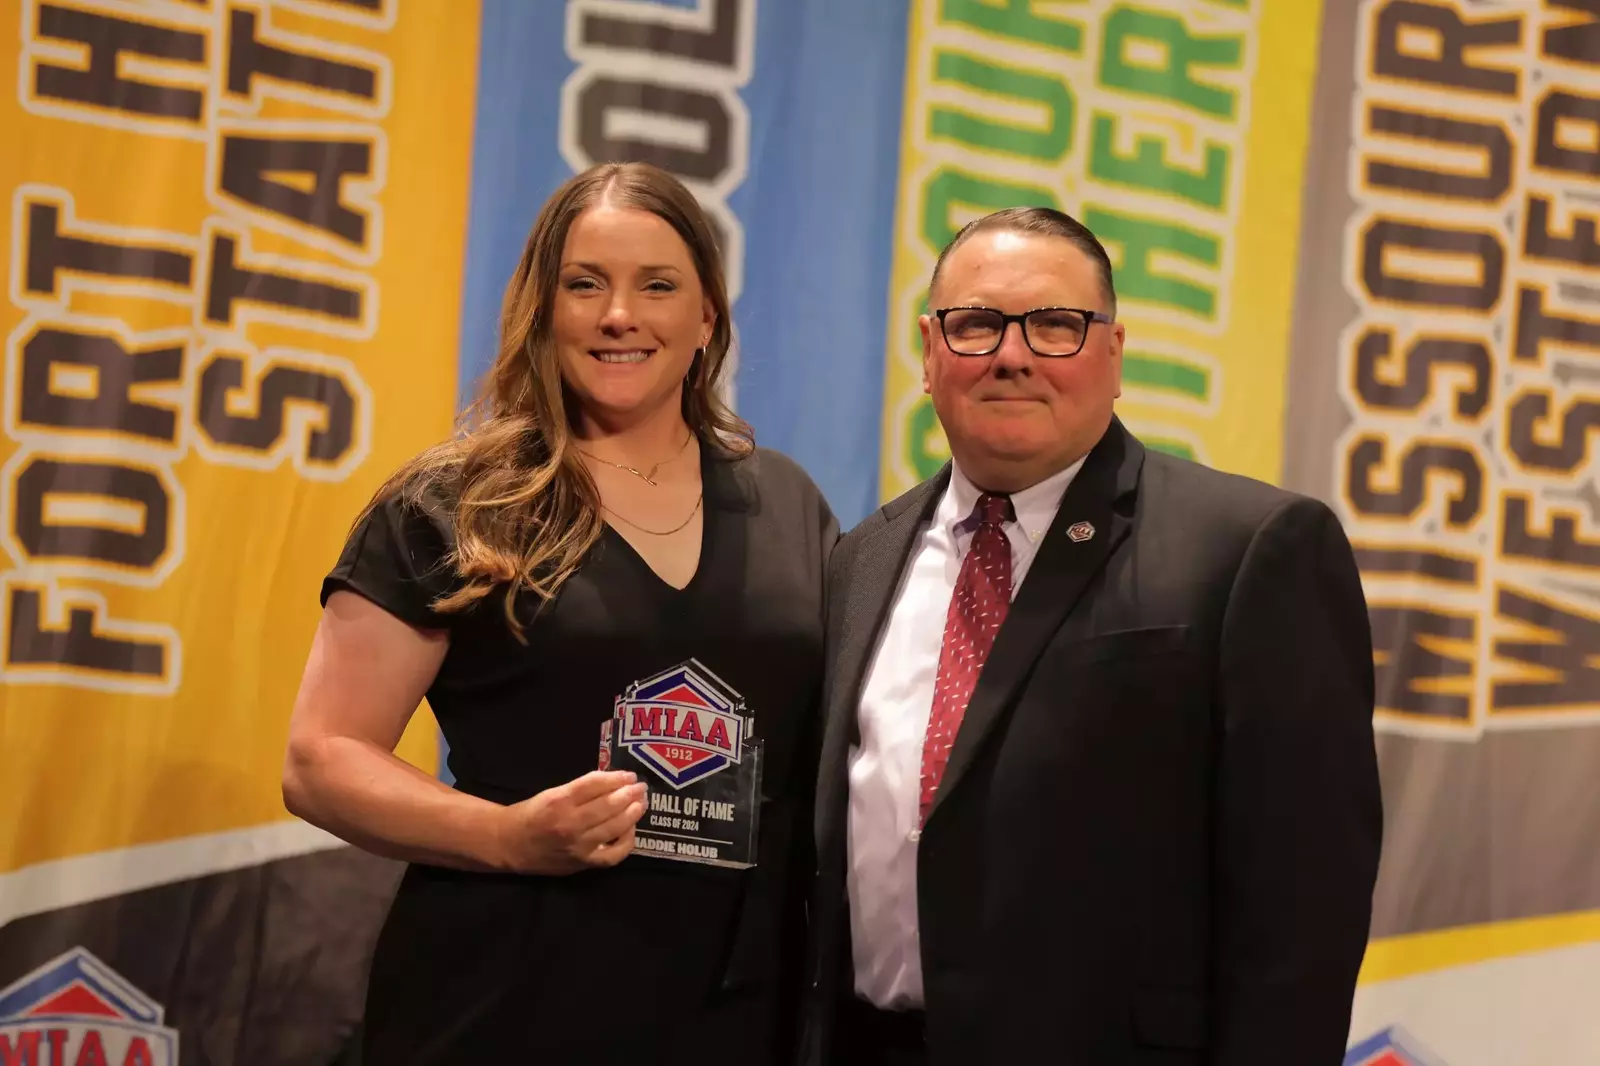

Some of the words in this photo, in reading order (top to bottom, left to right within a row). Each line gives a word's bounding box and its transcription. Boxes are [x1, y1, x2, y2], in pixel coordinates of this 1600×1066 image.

[195, 0, 392, 474] STAT
[3, 193, 203, 685] FORT
[629, 706, 732, 751] MIAA
[664, 747, 693, 761] 1912
[650, 792, 682, 815] HALL
[683, 796, 701, 817] OF
[701, 799, 736, 822] FAME
[650, 814, 672, 828] CLASS
[672, 817, 682, 829] OF
[681, 819, 700, 832] 2024
[677, 842, 719, 859] HOLUB
